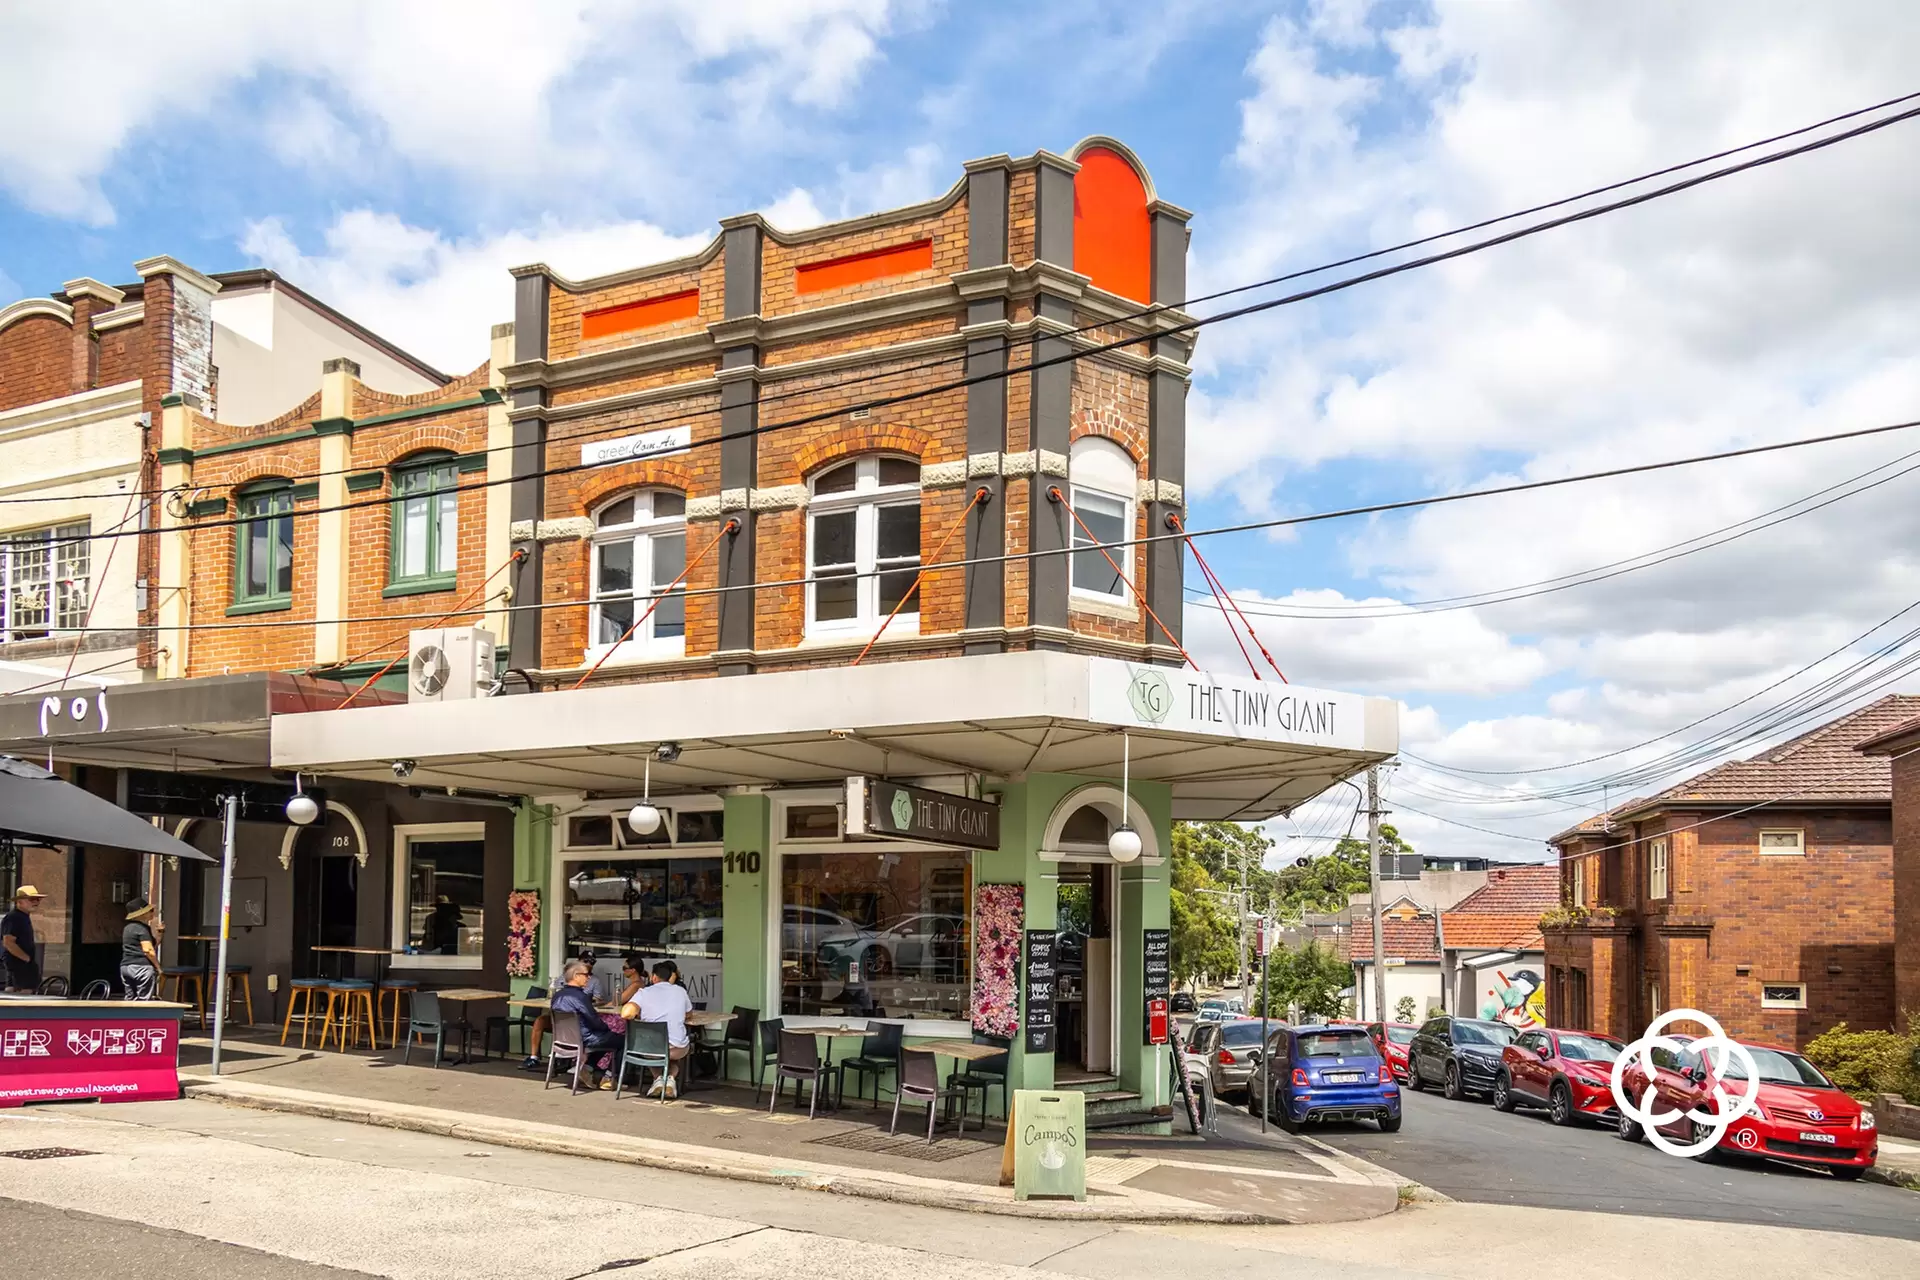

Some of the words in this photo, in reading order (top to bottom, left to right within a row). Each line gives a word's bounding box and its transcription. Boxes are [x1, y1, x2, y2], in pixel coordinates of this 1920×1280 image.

[1188, 683, 1223, 723] THE
[1232, 689, 1269, 728] TINY
[1277, 697, 1336, 736] GIANT
[916, 798, 935, 829] THE
[938, 803, 957, 833] TINY
[960, 808, 989, 837] GIANT
[332, 836, 349, 847] 108
[724, 851, 760, 873] 110
[606, 972, 625, 997] TH
[1155, 1001, 1163, 1010] NO
[0, 1029, 52, 1057] ER
[67, 1028, 167, 1056] WEST
